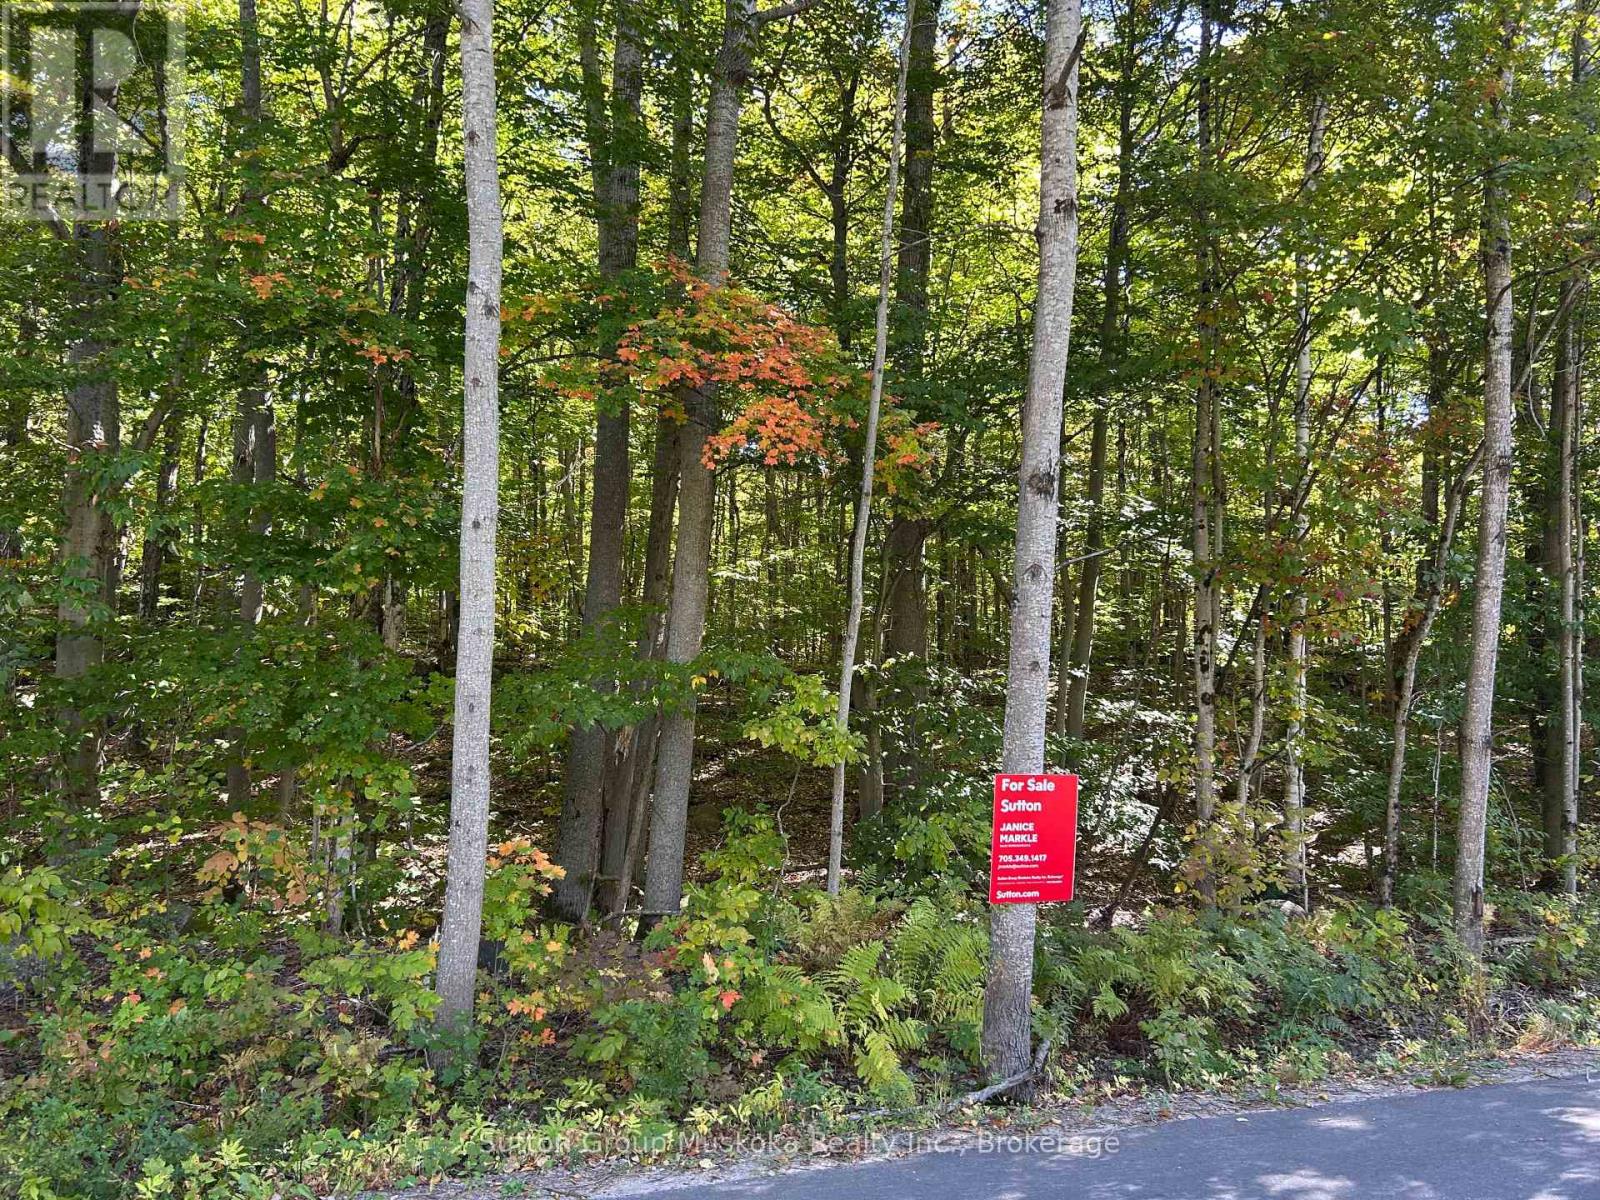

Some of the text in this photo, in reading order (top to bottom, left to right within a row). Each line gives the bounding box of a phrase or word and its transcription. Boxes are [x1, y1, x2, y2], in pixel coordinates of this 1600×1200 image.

[1001, 778, 1055, 791] For Sale
[1001, 799, 1042, 812] Sutton
[1000, 822, 1034, 832] JANICE
[999, 834, 1038, 843] MARKLE
[998, 854, 1047, 863] 705.349.1417
[996, 891, 1040, 899] Sutton.com
